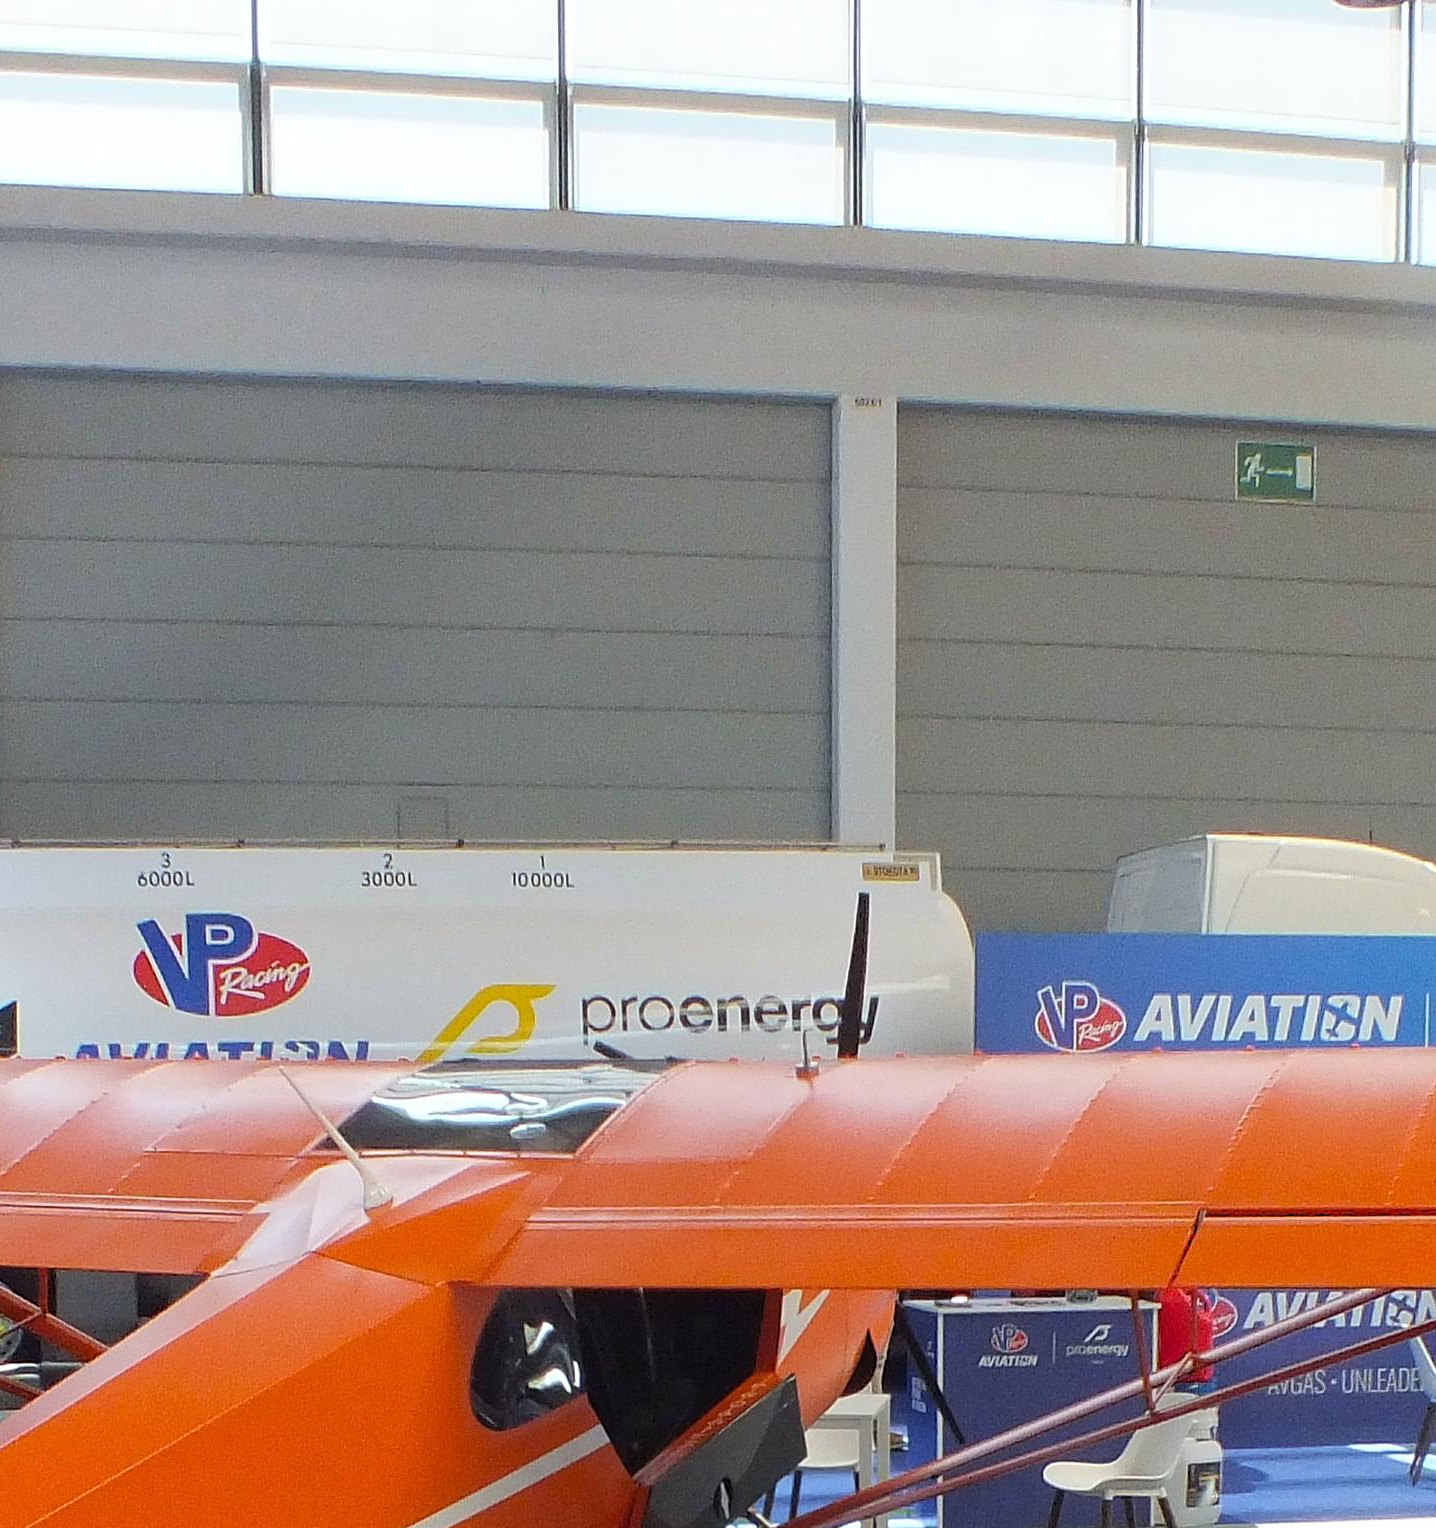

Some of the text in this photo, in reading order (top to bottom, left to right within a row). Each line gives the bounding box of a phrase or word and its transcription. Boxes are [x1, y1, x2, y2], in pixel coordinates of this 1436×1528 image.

[161, 853, 171, 869] 3
[382, 853, 393, 870] 2
[137, 871, 195, 888] 6000L
[361, 871, 418, 887] 3000L
[134, 912, 257, 1016] VP
[219, 960, 311, 1004] Racing
[580, 994, 880, 1046] proenergy
[1037, 980, 1100, 1050] VP
[1133, 994, 1403, 1042] AVIATION
[978, 1354, 1038, 1368] AVIATION
[1342, 1368, 1425, 1394] UNLEADE
